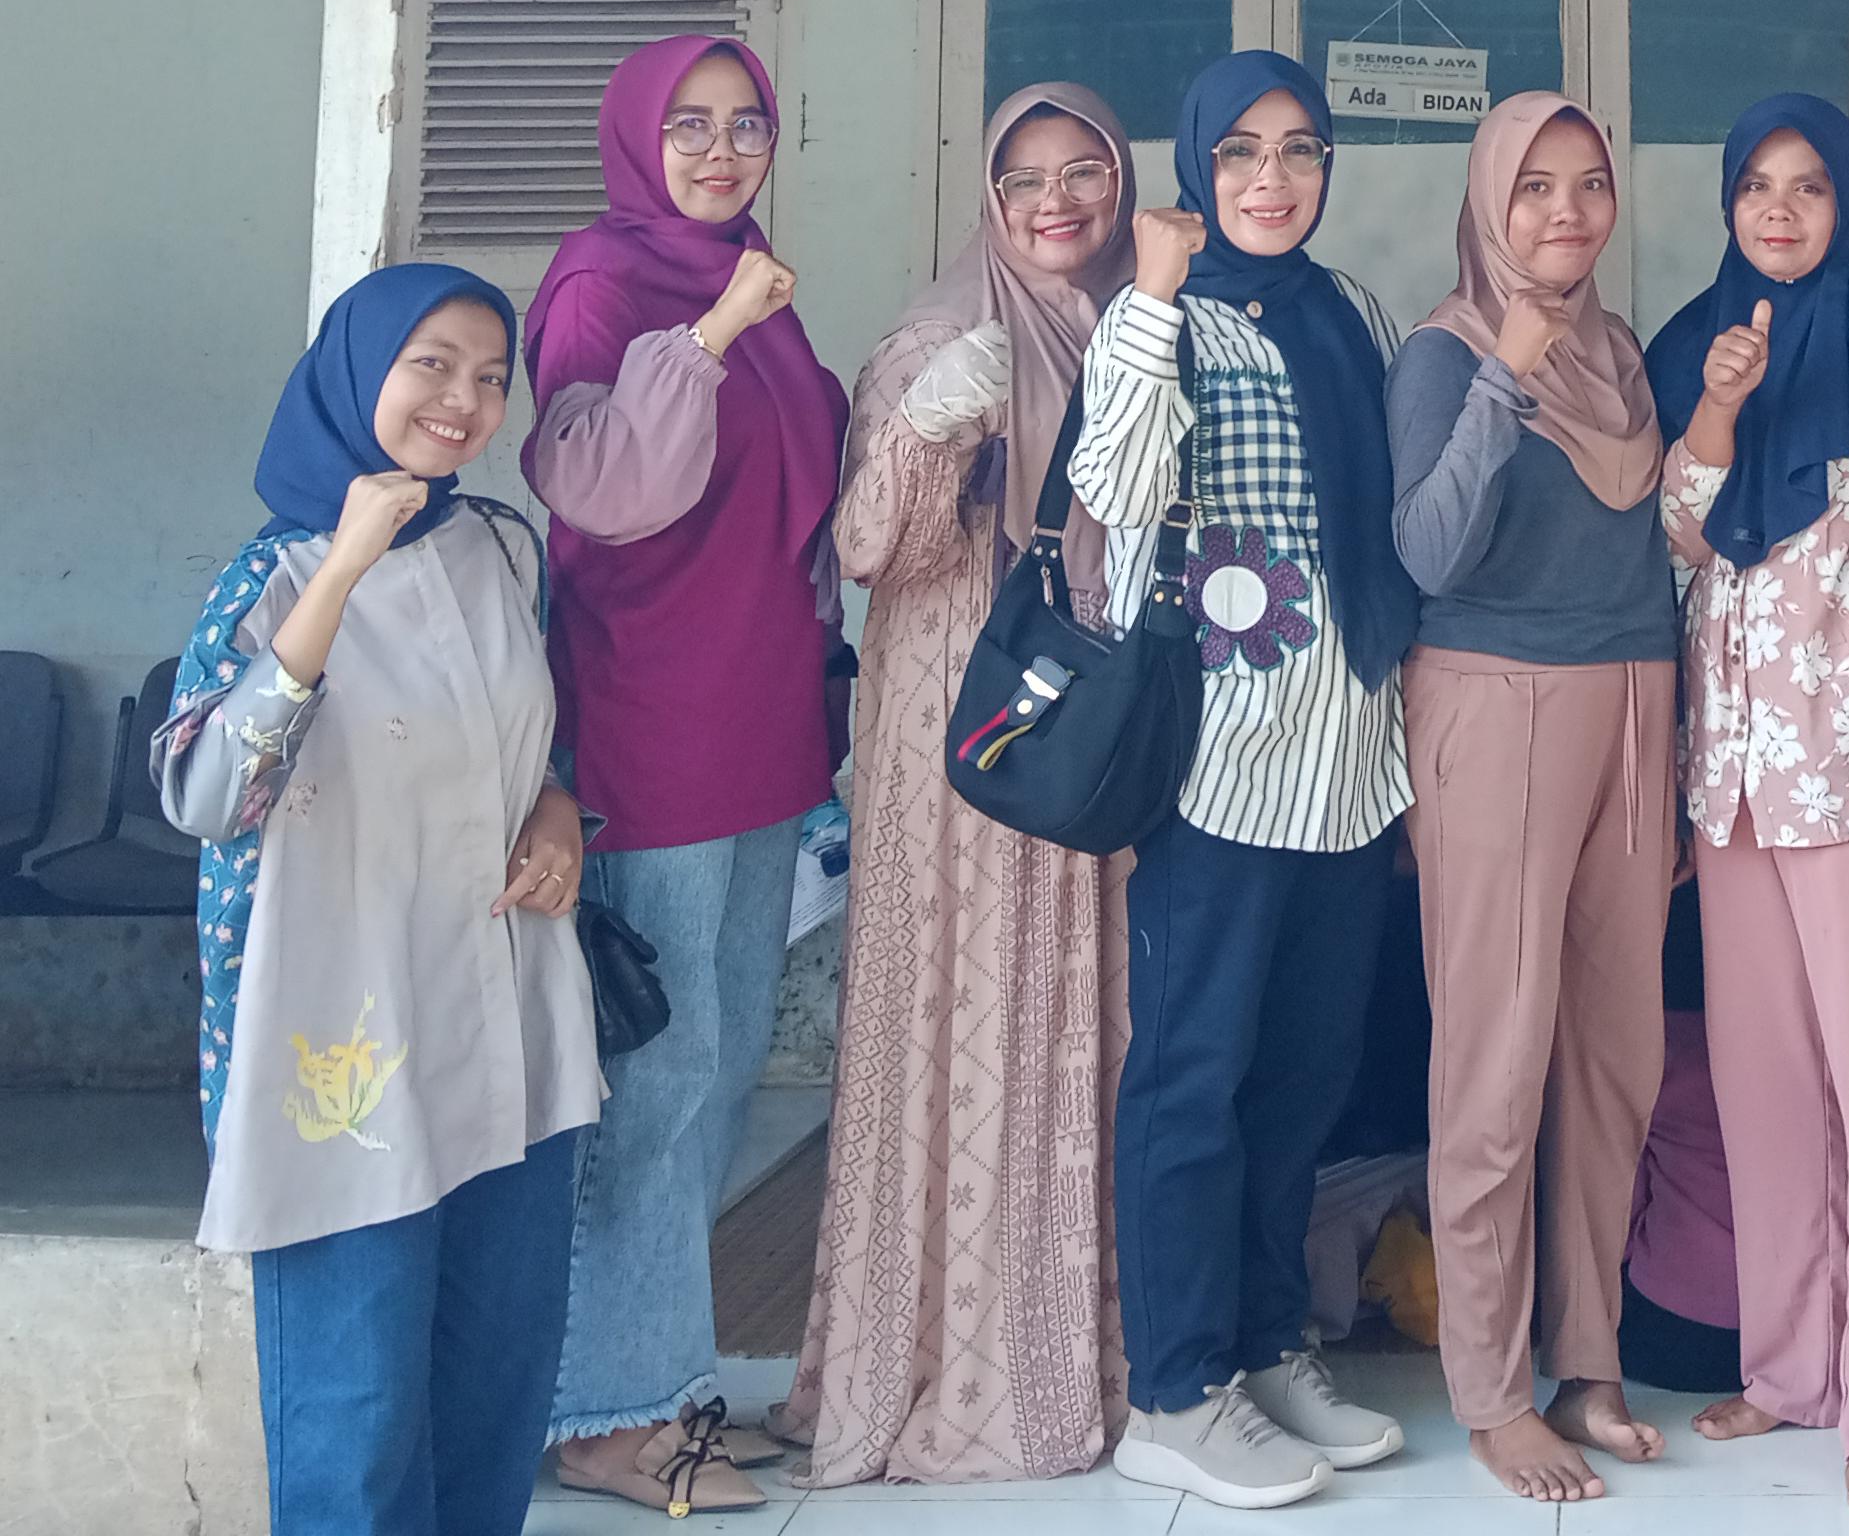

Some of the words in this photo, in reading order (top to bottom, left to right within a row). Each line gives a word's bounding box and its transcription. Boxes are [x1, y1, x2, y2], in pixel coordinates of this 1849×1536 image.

[1354, 53, 1428, 66] SEMOGA
[1434, 58, 1478, 69] JAYA
[1348, 86, 1387, 105] Ada
[1422, 94, 1484, 112] BIDAN
